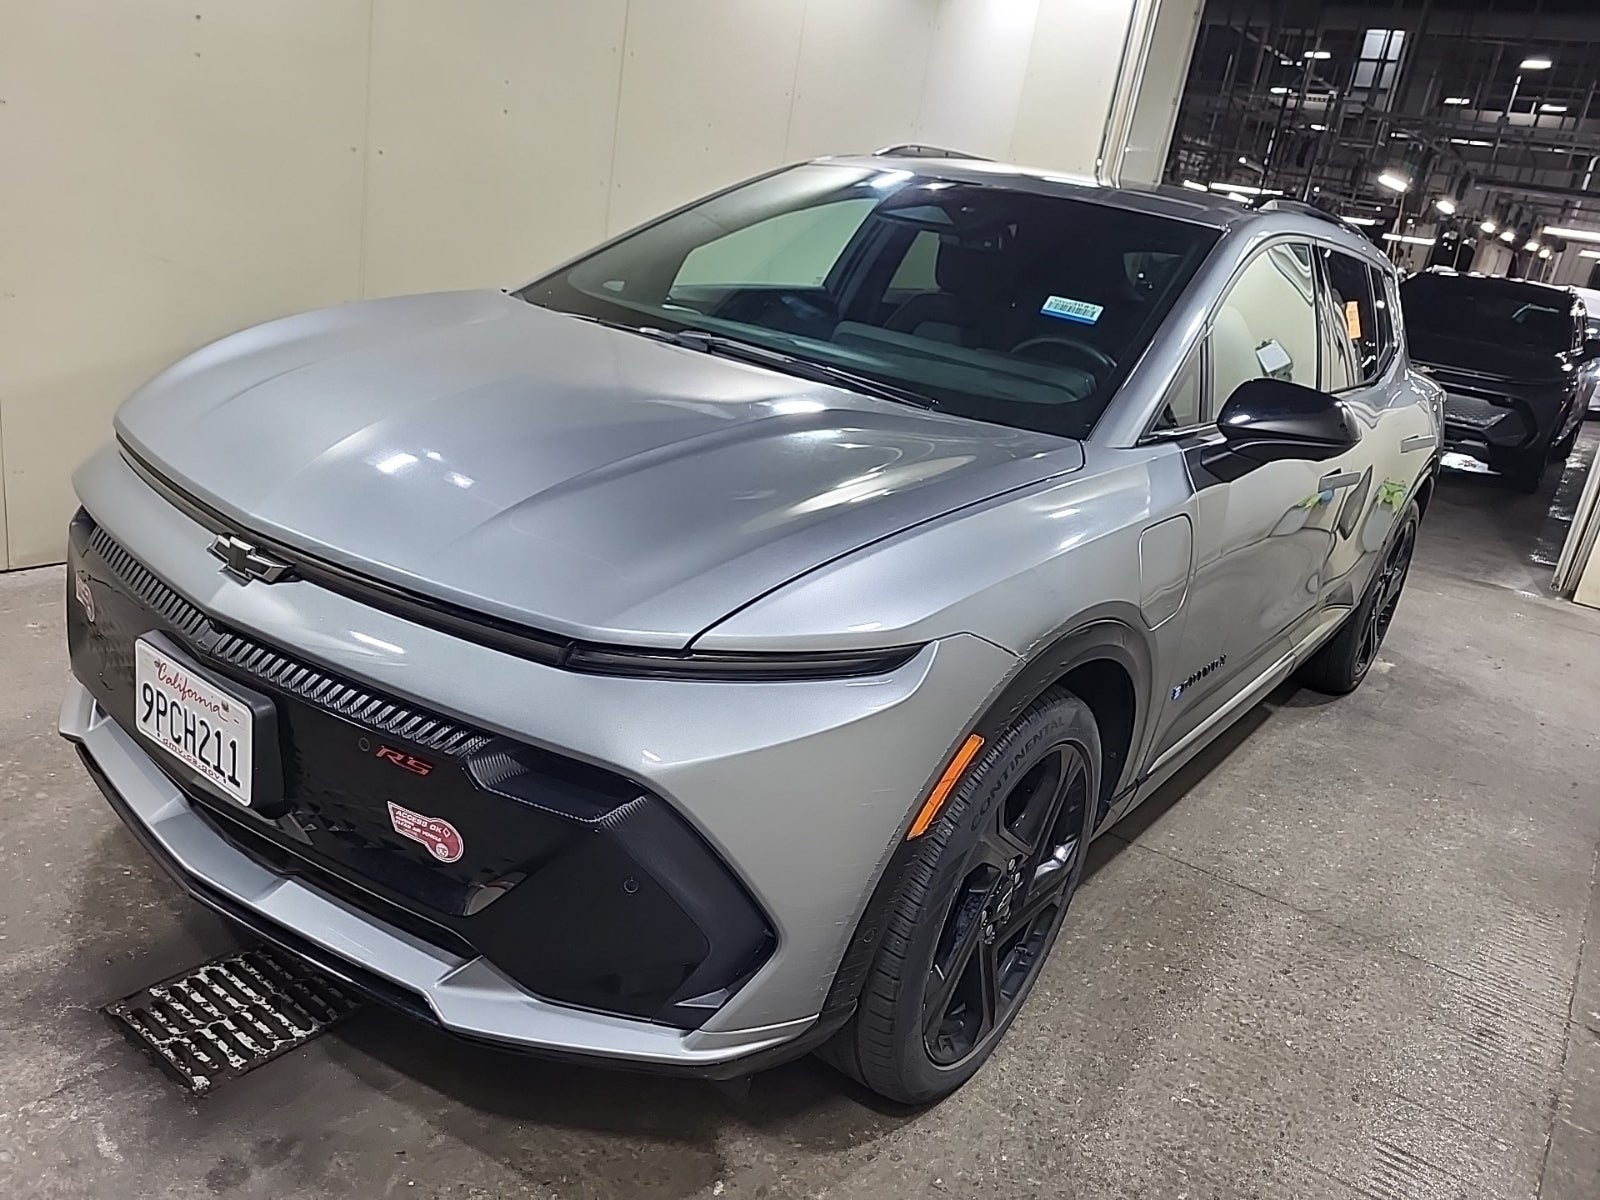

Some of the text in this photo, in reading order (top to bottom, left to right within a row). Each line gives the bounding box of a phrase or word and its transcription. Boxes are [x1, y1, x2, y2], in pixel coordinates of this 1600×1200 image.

[158, 662, 229, 722] California
[142, 682, 241, 788] 9PCH211
[162, 737, 221, 780] dmv.ca.gov
[375, 745, 433, 776] RS
[971, 716, 1065, 832] CONTINENTAL
[395, 810, 428, 828] ACCESS
[429, 824, 442, 834] OK
